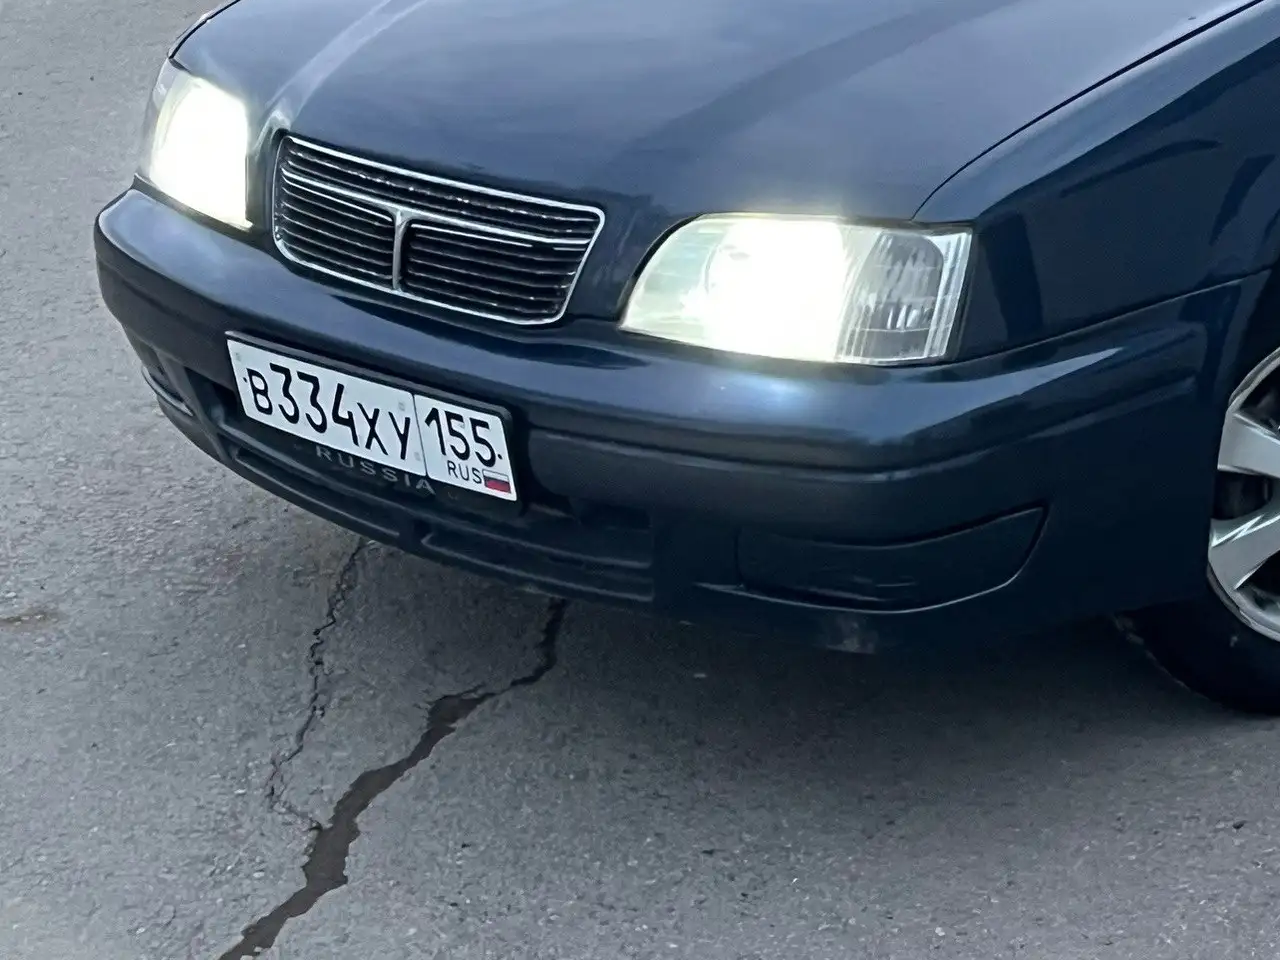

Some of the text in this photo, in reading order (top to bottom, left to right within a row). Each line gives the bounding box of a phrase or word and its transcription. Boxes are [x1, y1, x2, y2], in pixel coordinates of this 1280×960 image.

[246, 363, 497, 467] В334ХУ 155
[315, 446, 436, 495] RUSSIA
[447, 460, 482, 484] RUS
